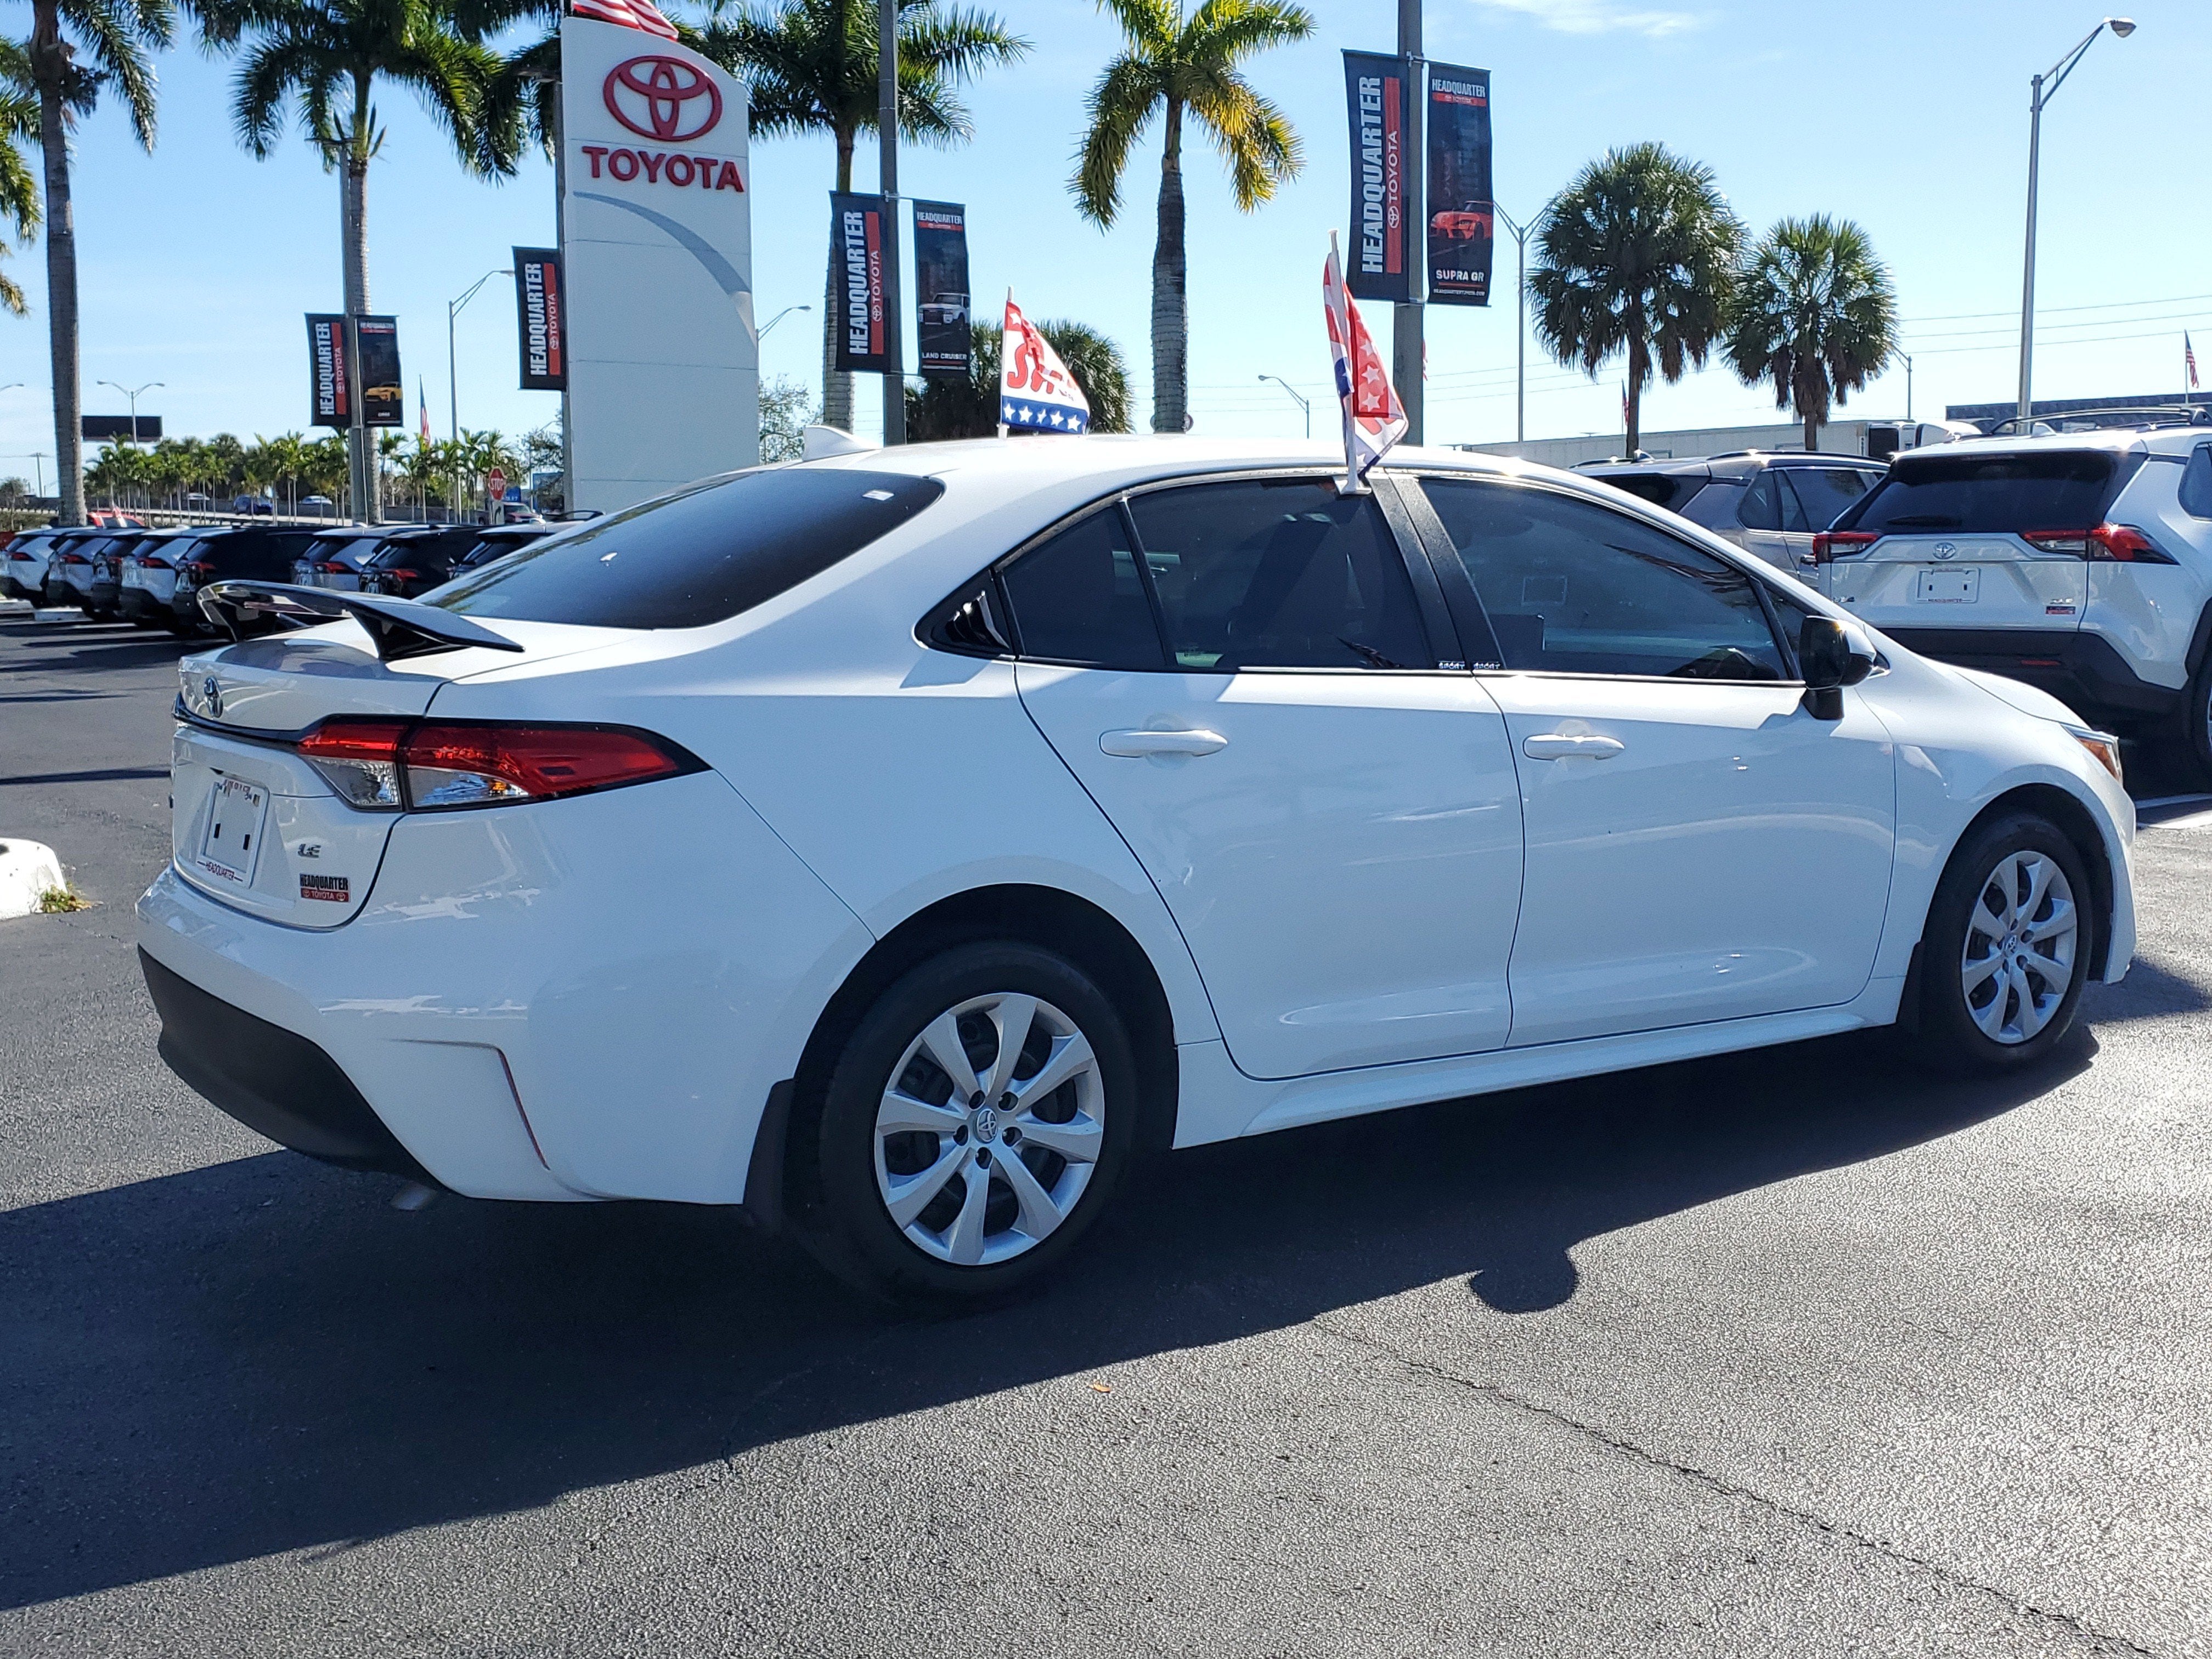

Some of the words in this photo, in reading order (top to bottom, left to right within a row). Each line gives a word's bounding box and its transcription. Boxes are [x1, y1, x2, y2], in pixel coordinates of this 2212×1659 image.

[1432, 78, 1485, 97] HEADQUARTER
[582, 145, 744, 193] TOYOTA
[1359, 76, 1386, 273] HEADQUARTER
[1388, 131, 1398, 204] TOYOTA
[917, 211, 962, 224] HEADQUARTER
[844, 211, 870, 354] HEADQUARTER
[870, 251, 881, 304] TOYOTA
[1436, 269, 1469, 280] SUPRA
[1471, 272, 1484, 282] GR
[525, 263, 548, 375] HEADQUARTER
[548, 294, 557, 335] TOYOTA
[315, 323, 335, 415] HEADQUARTER
[335, 347, 345, 386] TOYOTA
[490, 478, 504, 491] STOP
[297, 844, 321, 858] LE
[300, 874, 348, 890] HEADQUARTER
[311, 891, 335, 900] TOYOTA
